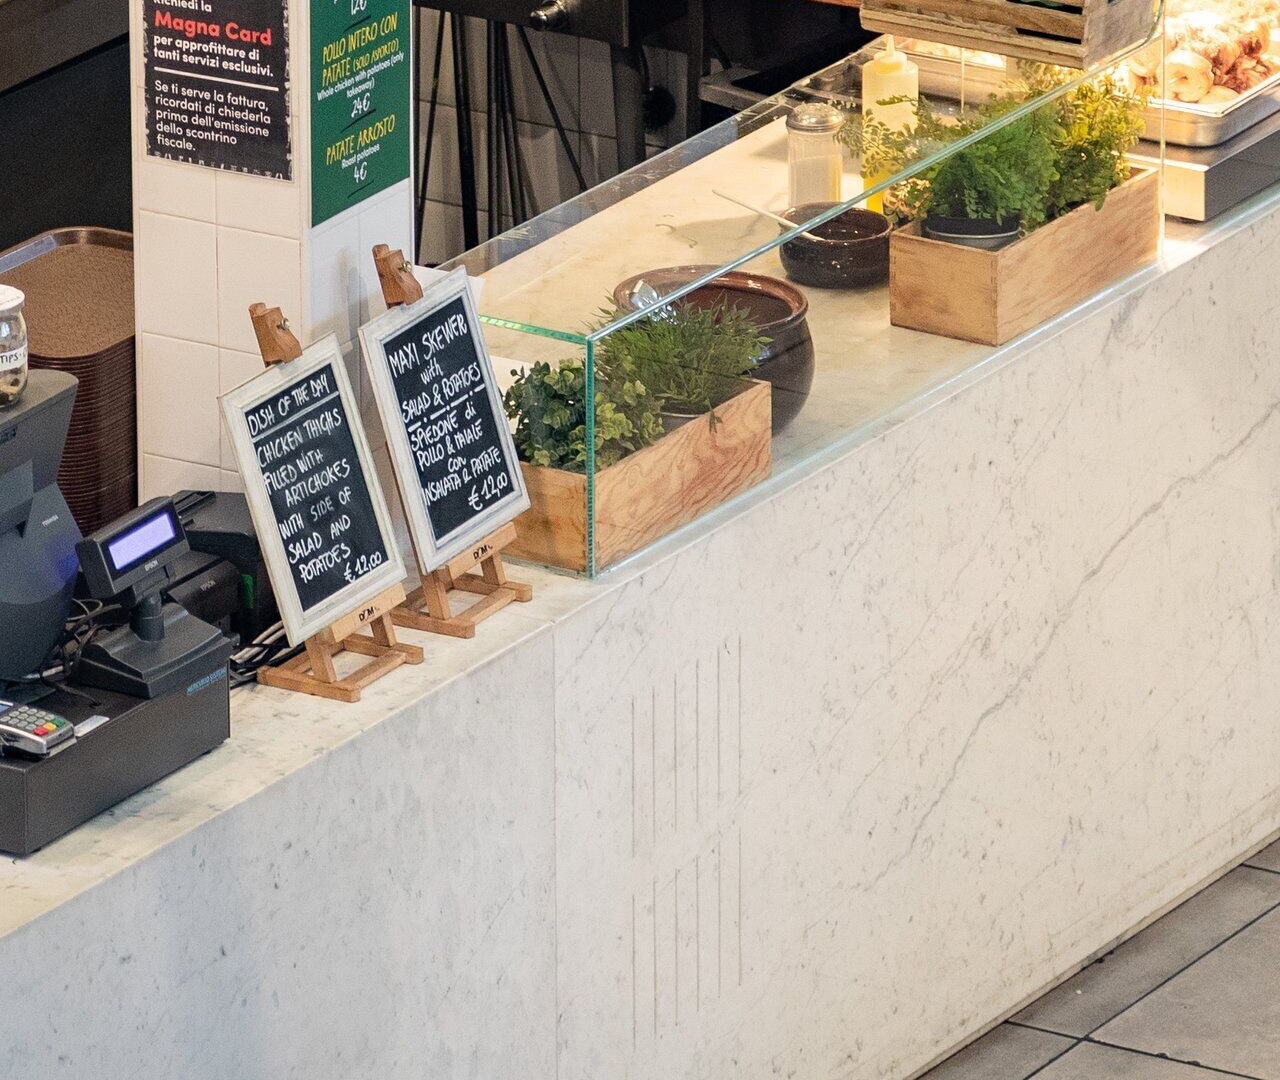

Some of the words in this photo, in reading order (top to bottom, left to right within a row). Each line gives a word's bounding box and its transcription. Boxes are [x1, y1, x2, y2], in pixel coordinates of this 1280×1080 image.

[201, 0, 212, 12] la
[153, 35, 173, 46] per
[175, 39, 246, 59] approfittare
[248, 49, 259, 61] di
[155, 10, 220, 38] Magna
[225, 21, 272, 46] Card
[323, 38, 346, 64] POLLO
[348, 22, 378, 53] INTERO
[380, 11, 397, 36] CON
[154, 48, 180, 61] tanti
[182, 54, 219, 68] servizi
[222, 60, 274, 77] esclusivi.
[322, 57, 351, 87] PATATE
[353, 53, 370, 72] (SOLO
[371, 37, 399, 63] ASPORTO)
[155, 80, 169, 92] Se
[171, 84, 178, 94] ti
[181, 88, 211, 100] serve
[214, 90, 224, 103] la
[227, 93, 269, 111] fattura,
[155, 94, 202, 112] ricordati
[205, 103, 215, 115] di
[218, 106, 270, 124] chiederla
[351, 92, 370, 118] 24€
[156, 109, 188, 123] prima
[191, 115, 270, 137] dell'emissione
[156, 122, 183, 135] dello
[186, 127, 237, 145] scontrino
[156, 134, 196, 151] fiscale.
[326, 135, 354, 165] PATATE
[357, 114, 395, 150] ARROSTO
[354, 161, 367, 183] 4€
[0, 353, 19, 364] TIPS
[388, 343, 420, 378] MAXI
[421, 313, 468, 361] SKEWER
[402, 393, 430, 424] SALAD
[432, 383, 443, 405] &
[442, 361, 481, 398] POTATOES
[420, 358, 444, 386] with
[247, 404, 275, 437] DISH
[277, 394, 292, 417] OF
[292, 383, 310, 408] THE
[310, 373, 330, 400] DAY
[257, 428, 304, 468] CHICKEN
[303, 407, 343, 439] THIGHS
[410, 410, 459, 452] SPIEDONE
[464, 401, 477, 420] di
[417, 442, 445, 472] POLLO
[445, 435, 455, 454] &
[454, 418, 484, 449] MAIALE
[261, 463, 298, 496] FILLED
[298, 450, 324, 475] WITH
[285, 458, 351, 508] ARTICHOKES
[422, 472, 462, 506] INSALATA
[471, 445, 502, 479] PATATE
[447, 455, 467, 473] con
[467, 484, 483, 512] €
[480, 471, 508, 500] 12,00
[278, 511, 305, 540] WITH
[310, 498, 334, 521] SIDE
[338, 485, 353, 506] OF
[288, 533, 323, 564] SALAD
[330, 513, 351, 540] AND
[299, 542, 351, 585] POTATOES
[343, 561, 356, 583] €
[354, 551, 383, 574] 12,00
